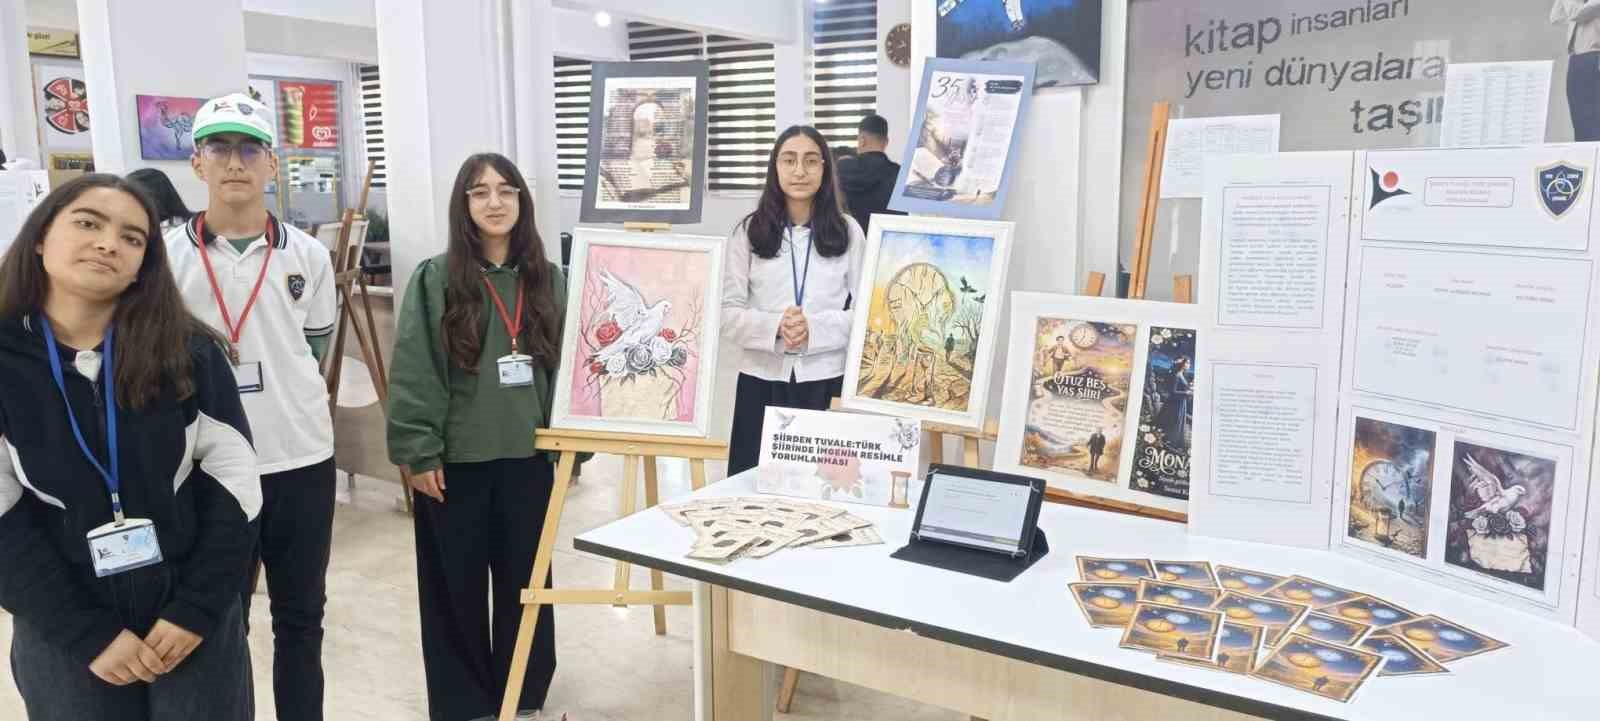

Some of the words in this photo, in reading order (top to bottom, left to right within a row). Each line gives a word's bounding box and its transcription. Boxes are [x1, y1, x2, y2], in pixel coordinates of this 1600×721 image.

[1184, 17, 1282, 56] kitap
[1290, 0, 1409, 35] insanları
[1184, 61, 1253, 98] yeni
[1264, 52, 1446, 92] dünyalara
[771, 451, 849, 466] YORUMLANMASI
[860, 450, 903, 462] RESİMLE
